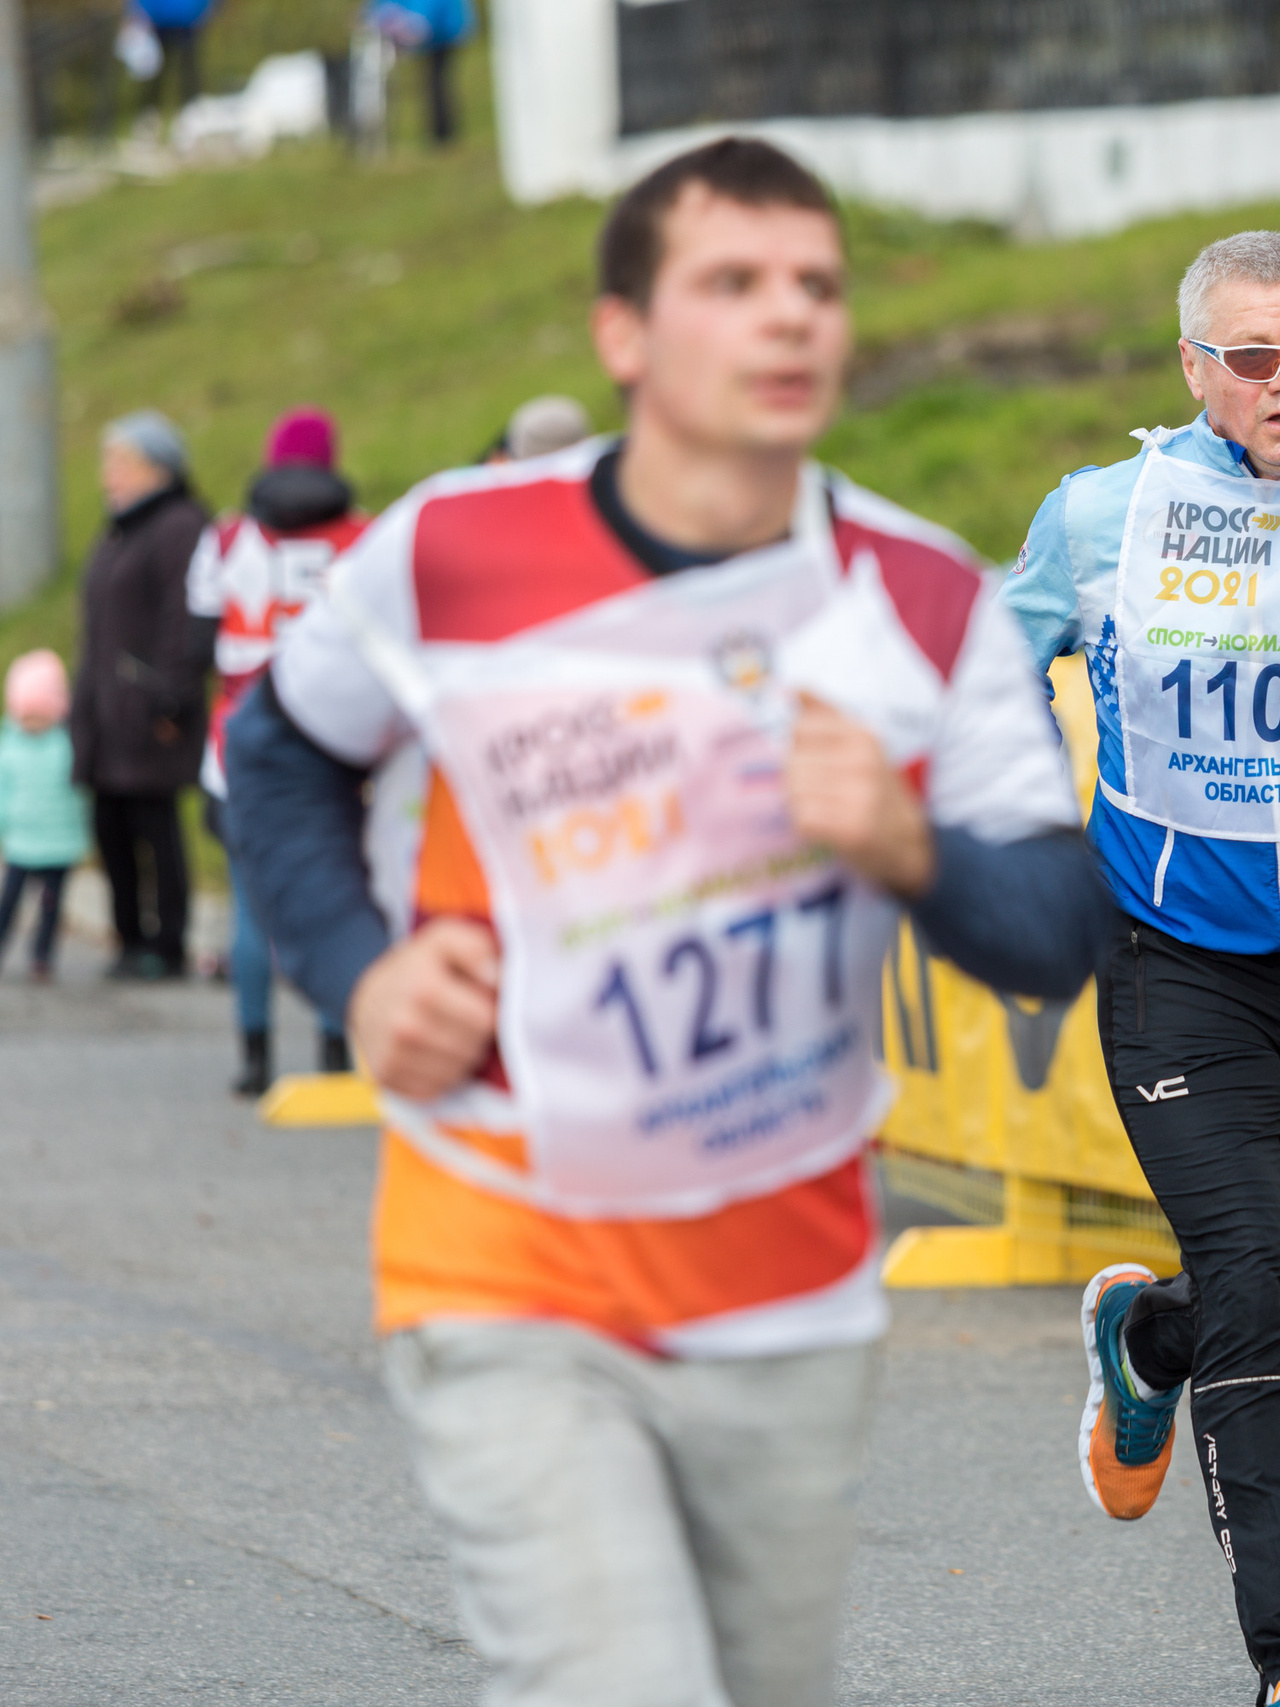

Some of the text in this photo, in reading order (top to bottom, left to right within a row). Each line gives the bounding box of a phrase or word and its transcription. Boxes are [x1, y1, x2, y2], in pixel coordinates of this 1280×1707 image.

[1166, 501, 1256, 533] КРОСС
[1161, 532, 1272, 567] НАЦИИ
[1154, 566, 1258, 606] 2021
[1147, 627, 1206, 648] СПОРТ
[592, 876, 848, 1081] 1277
